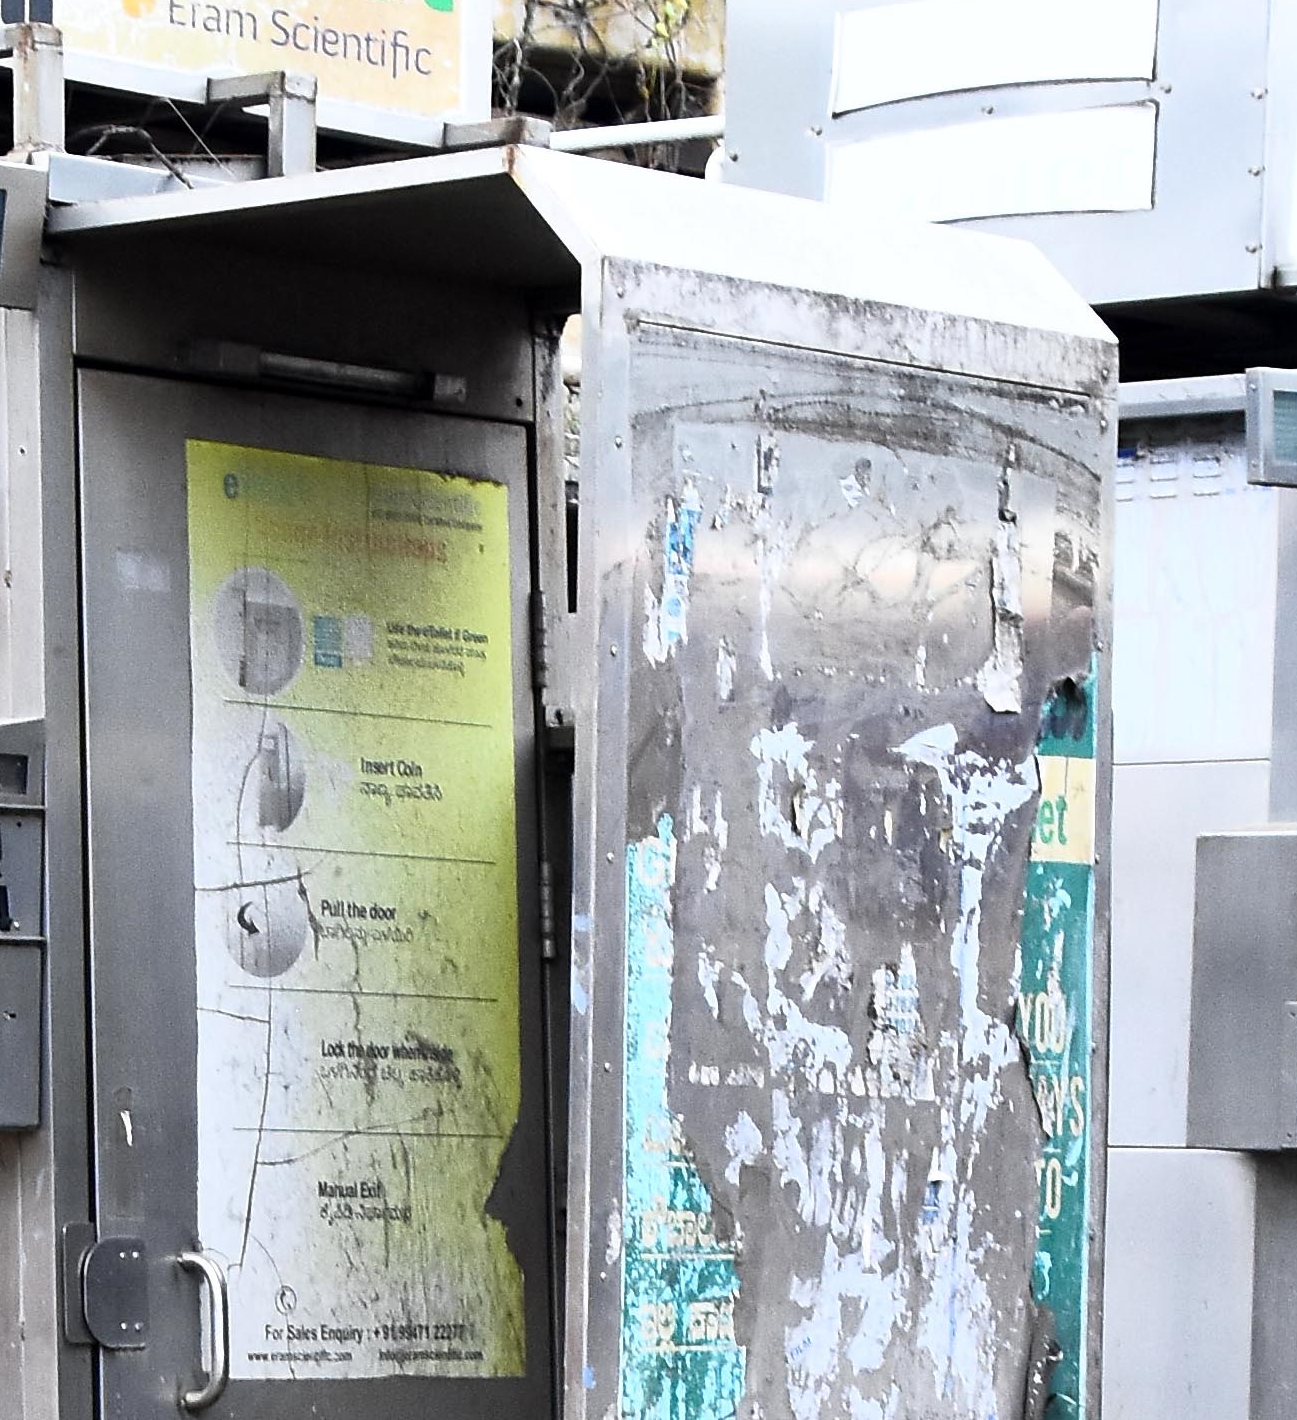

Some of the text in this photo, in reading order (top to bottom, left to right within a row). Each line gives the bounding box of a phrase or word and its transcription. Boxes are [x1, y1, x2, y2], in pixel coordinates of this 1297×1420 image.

[270, 7, 434, 80] Scientific
[360, 757, 423, 779] Insert Coin
[321, 899, 397, 920] Pull the door
[321, 1038, 345, 1058] Lock
[318, 1180, 358, 1199] Manual
[265, 1324, 283, 1341] For
[287, 1324, 317, 1341] Sales
[320, 1324, 362, 1345] Enquiry
